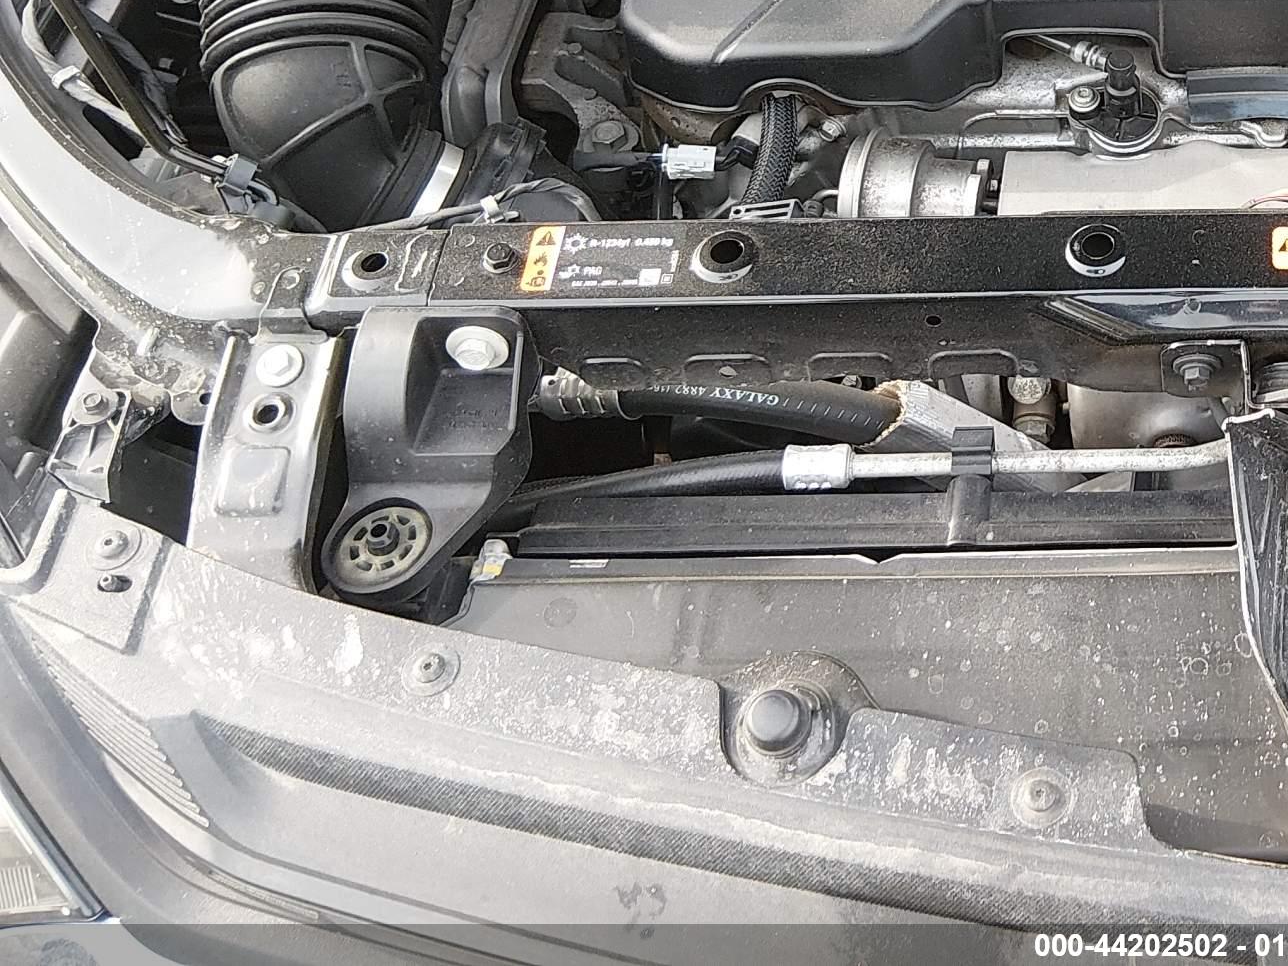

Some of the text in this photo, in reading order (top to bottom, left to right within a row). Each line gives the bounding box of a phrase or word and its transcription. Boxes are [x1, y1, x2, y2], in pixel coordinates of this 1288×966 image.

[583, 265, 603, 276] PAG
[674, 384, 708, 396] 4882
[709, 386, 780, 406] GALAXY
